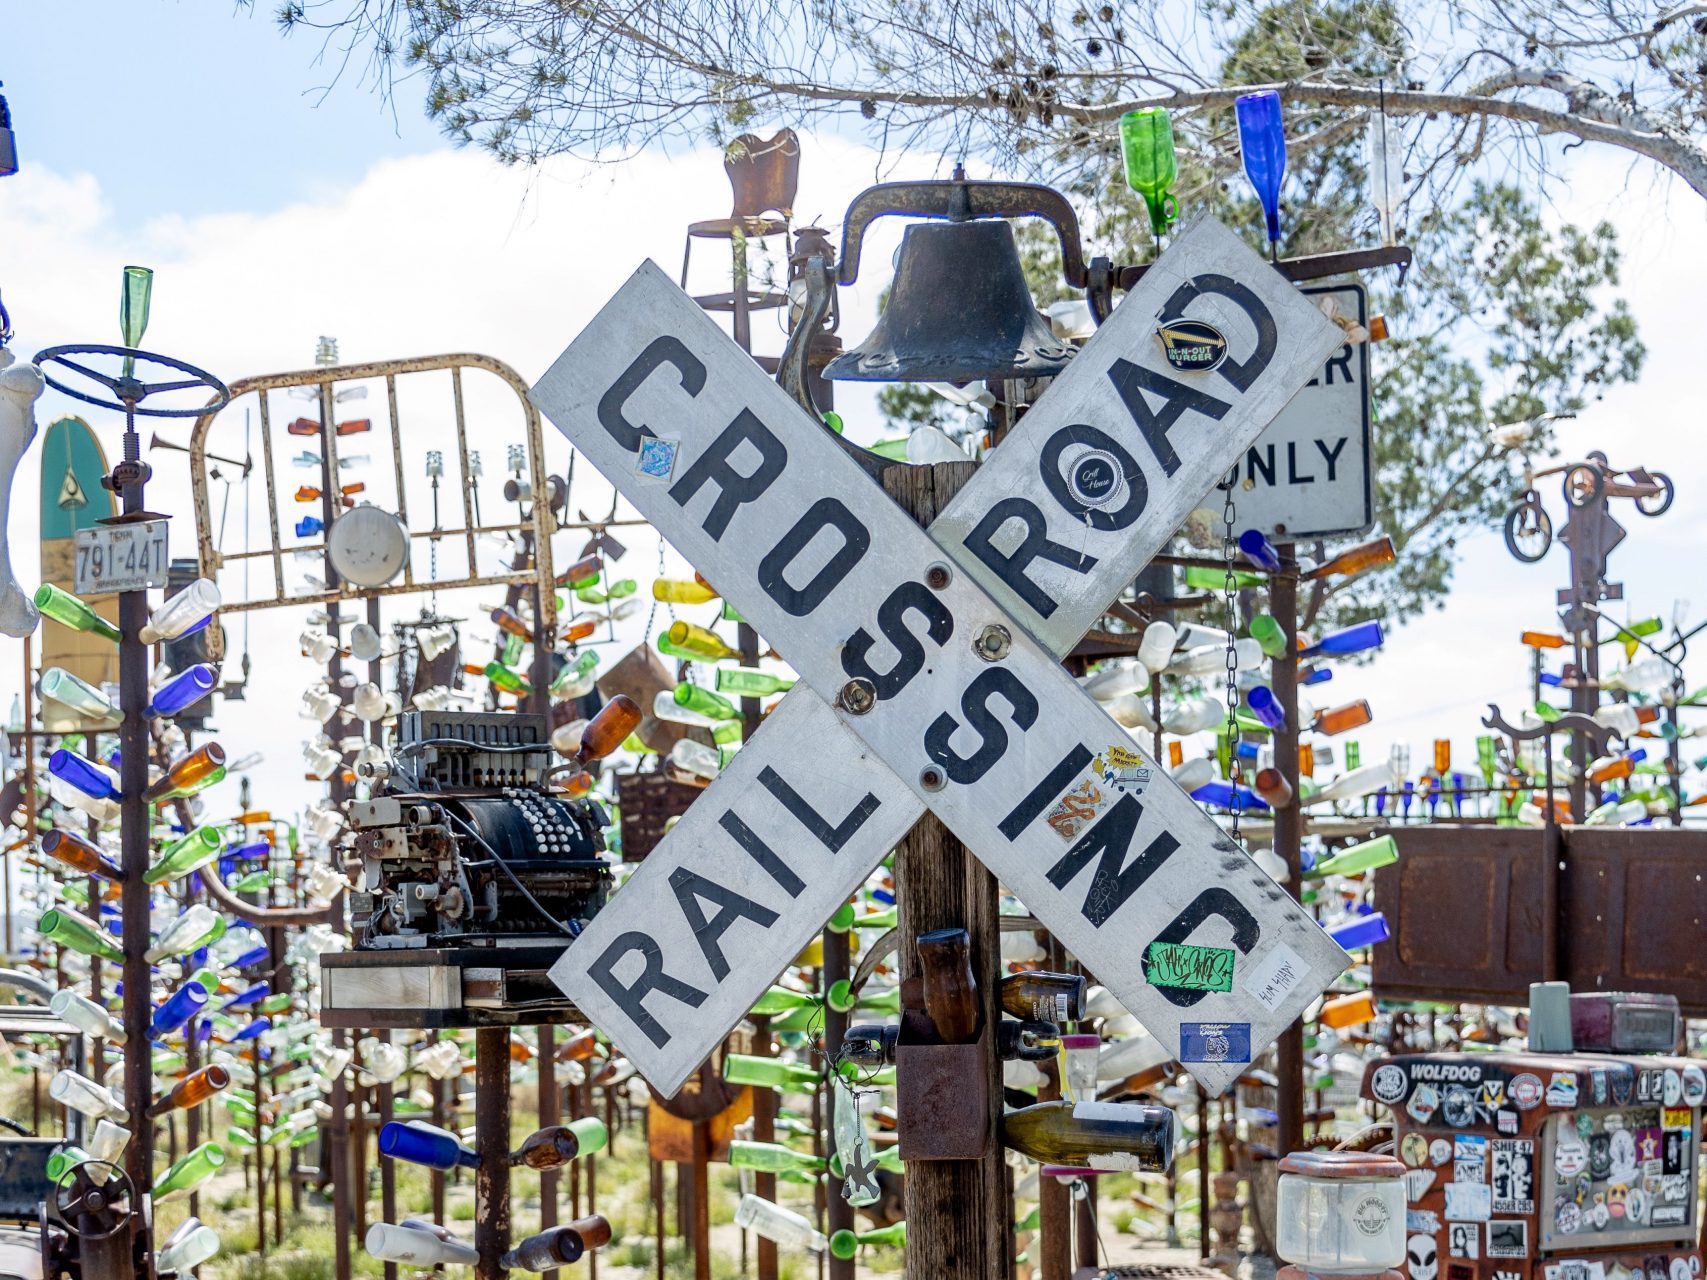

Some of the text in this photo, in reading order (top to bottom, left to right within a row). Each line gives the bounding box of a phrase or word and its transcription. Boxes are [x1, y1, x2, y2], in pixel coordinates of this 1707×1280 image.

[1168, 346, 1211, 355] IN-N-OUT
[1169, 353, 1212, 361] BURGER
[587, 273, 1277, 1049] RAIL ROAD
[597, 335, 1260, 1007] CROSSING
[1411, 1064, 1481, 1081] WOLFDOG
